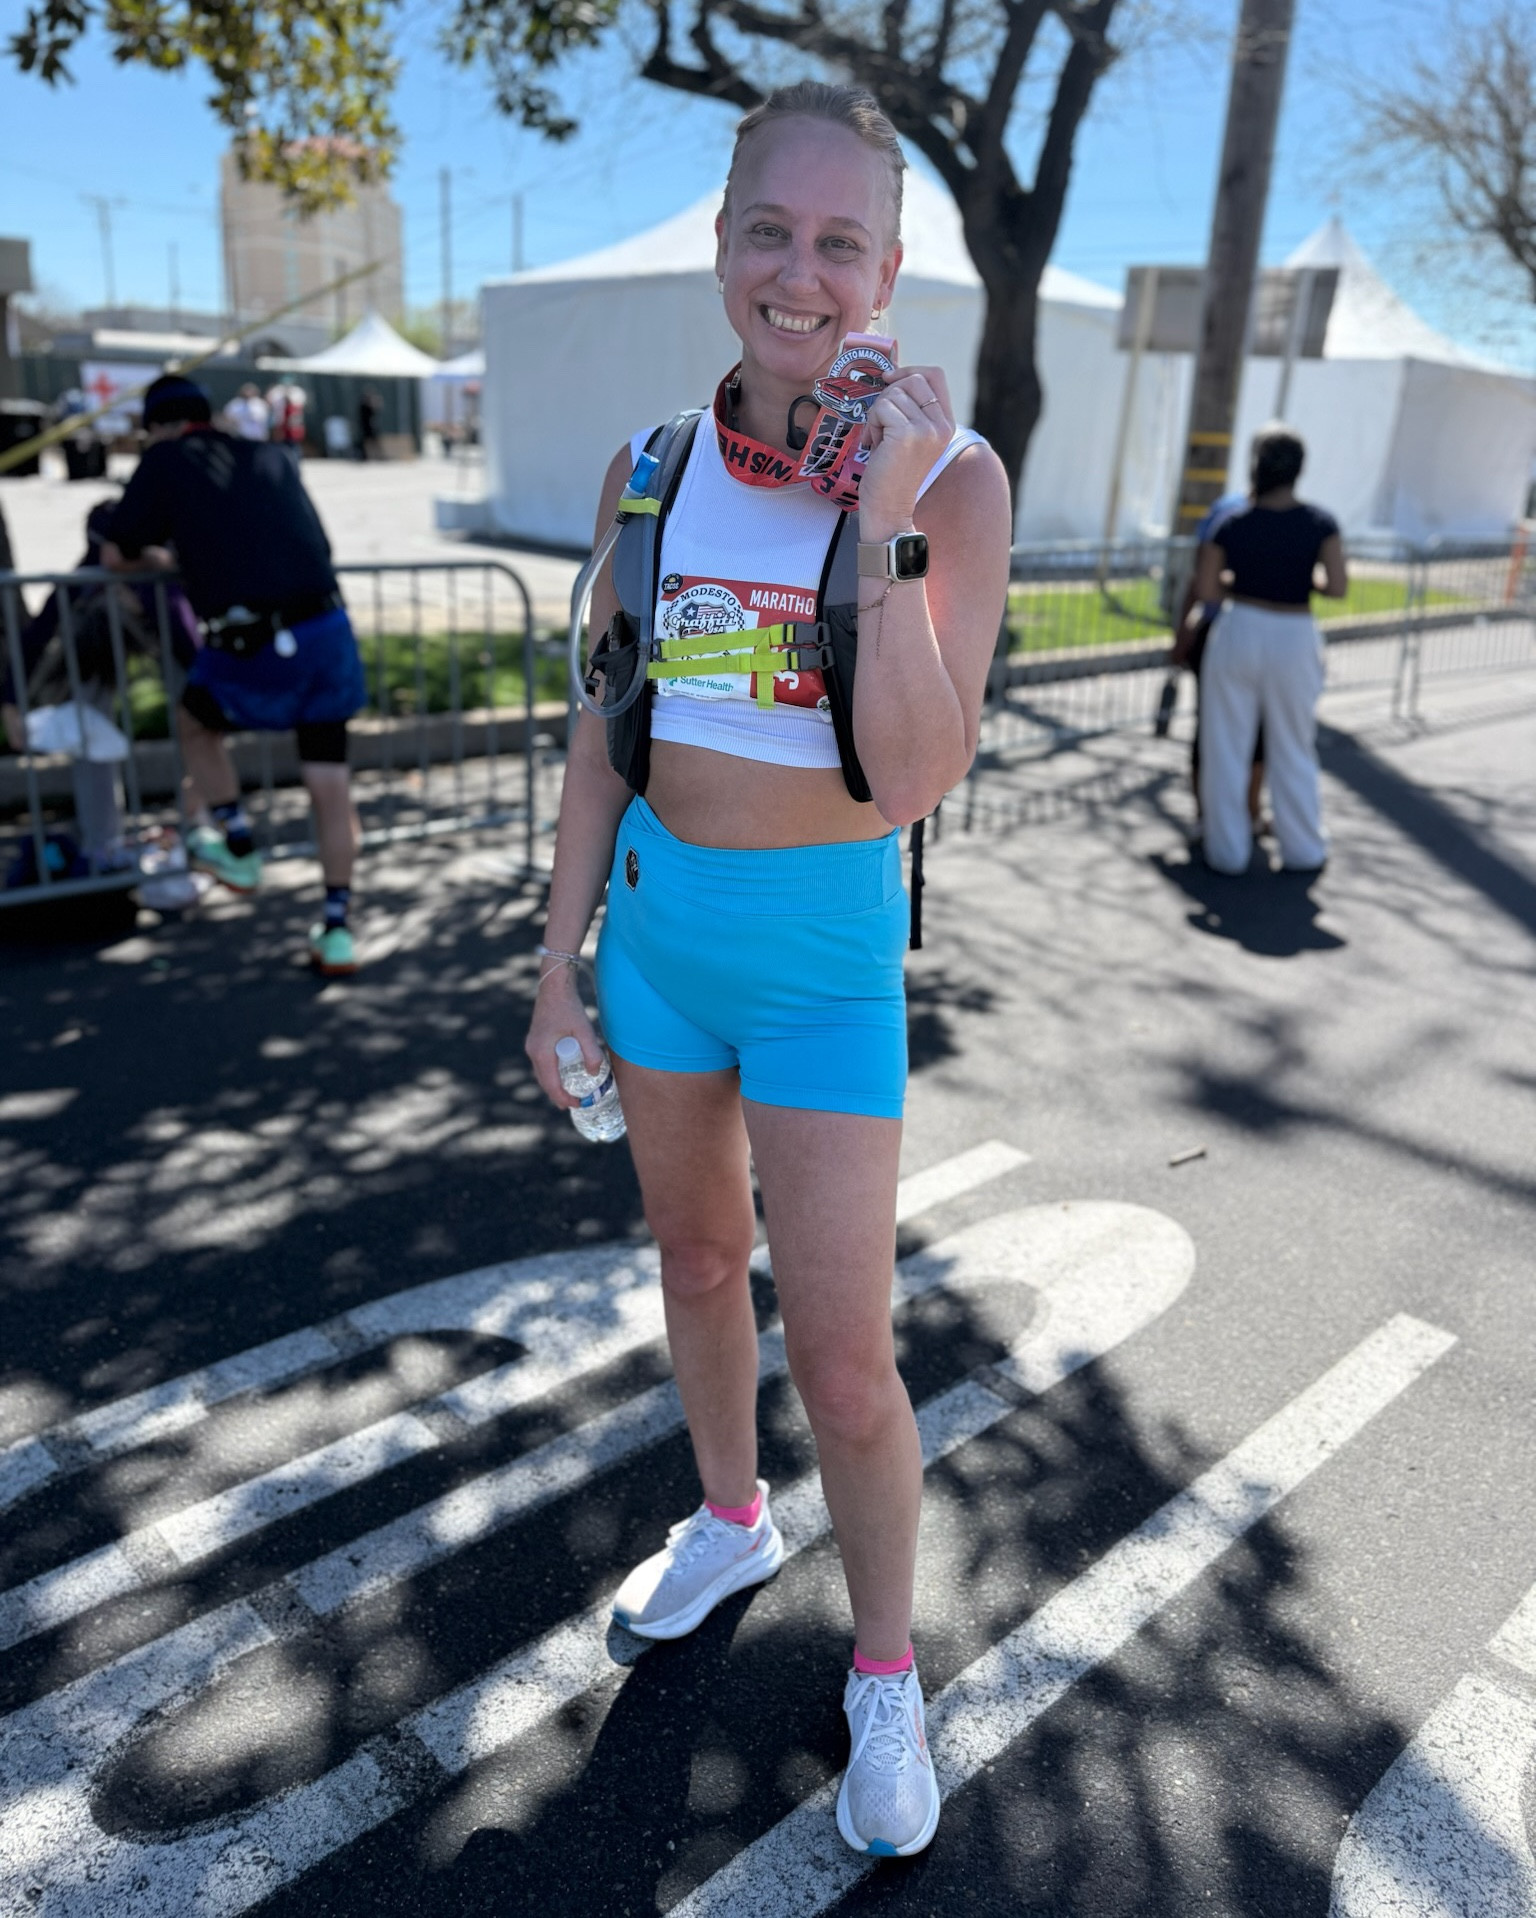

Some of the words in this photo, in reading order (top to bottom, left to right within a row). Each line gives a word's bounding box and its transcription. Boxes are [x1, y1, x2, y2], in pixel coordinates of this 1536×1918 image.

[830, 351, 858, 377] MODESTO
[680, 587, 737, 606] MODESTO
[749, 589, 817, 617] MARATHO
[669, 610, 737, 630] Graffiti
[680, 676, 706, 687] Sutter
[706, 679, 734, 692] Health
